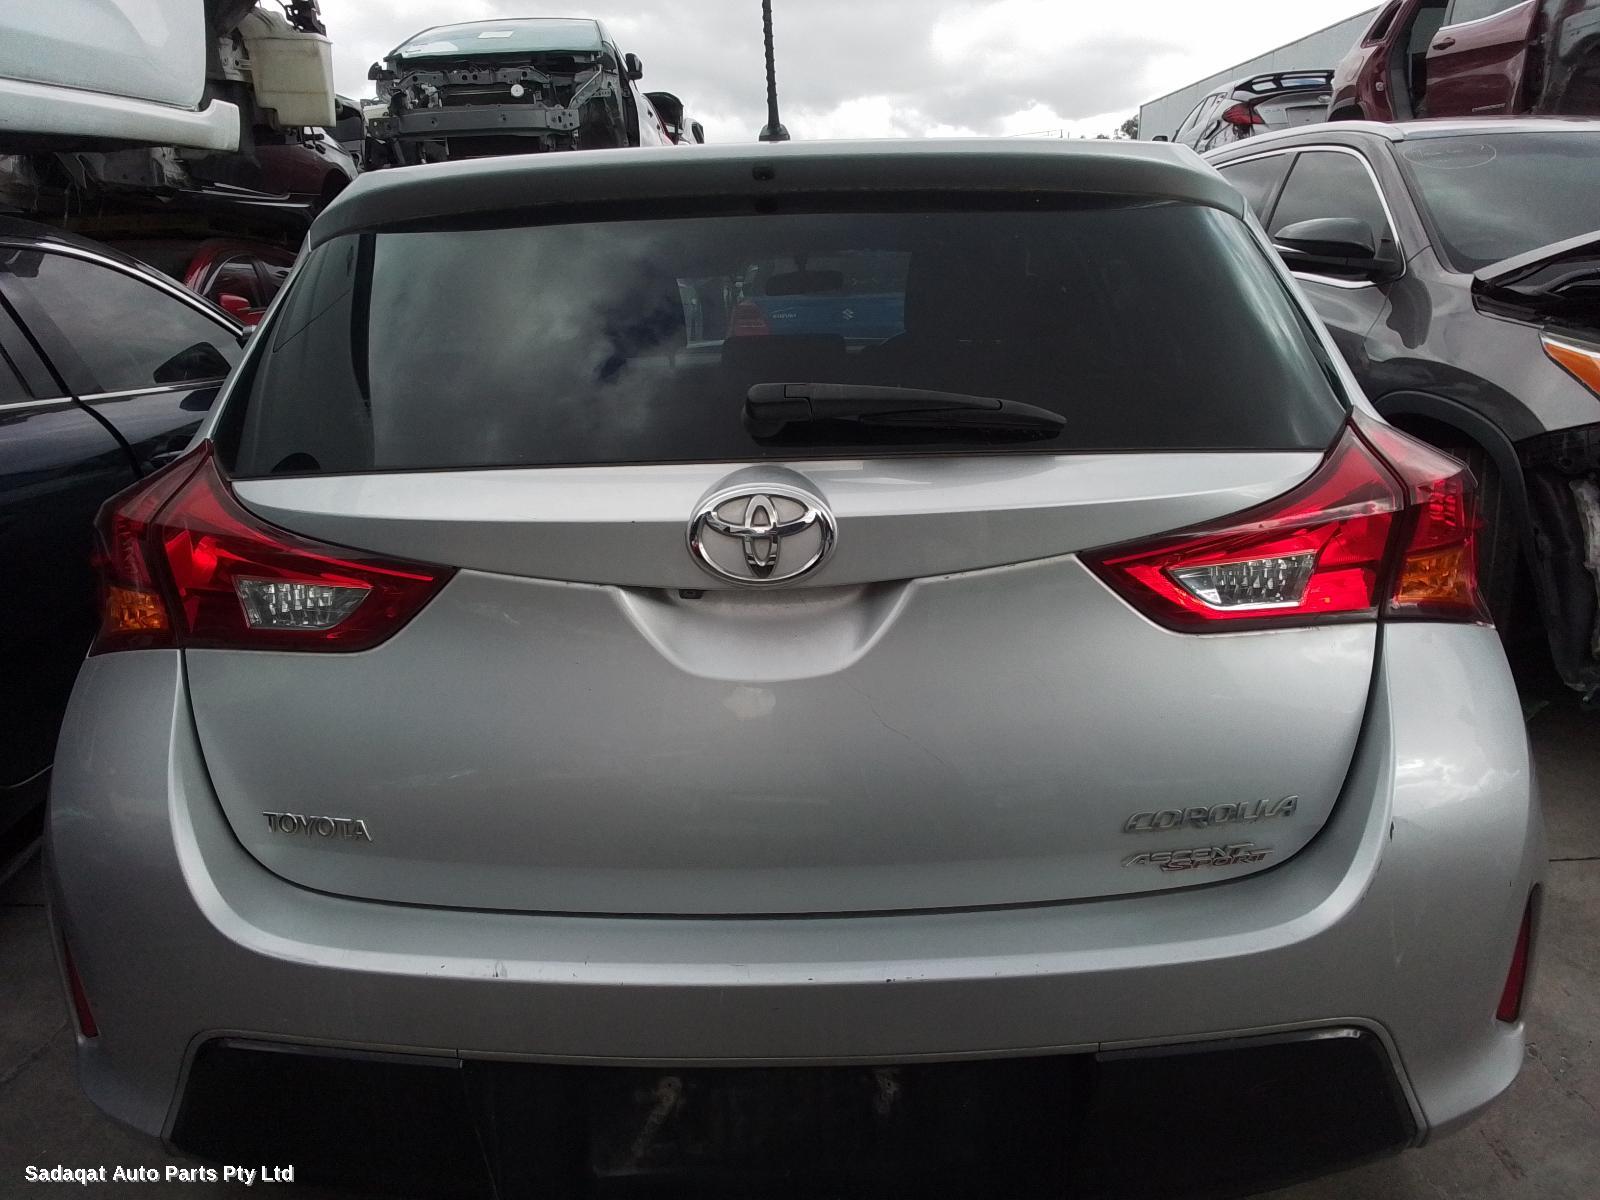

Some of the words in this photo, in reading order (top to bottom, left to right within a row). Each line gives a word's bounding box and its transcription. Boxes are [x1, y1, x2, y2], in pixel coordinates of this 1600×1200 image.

[262, 811, 372, 841] TOYOTA
[1123, 795, 1299, 832] COROLLA
[1121, 842, 1255, 868] ASCENT
[1161, 848, 1273, 872] SPORT
